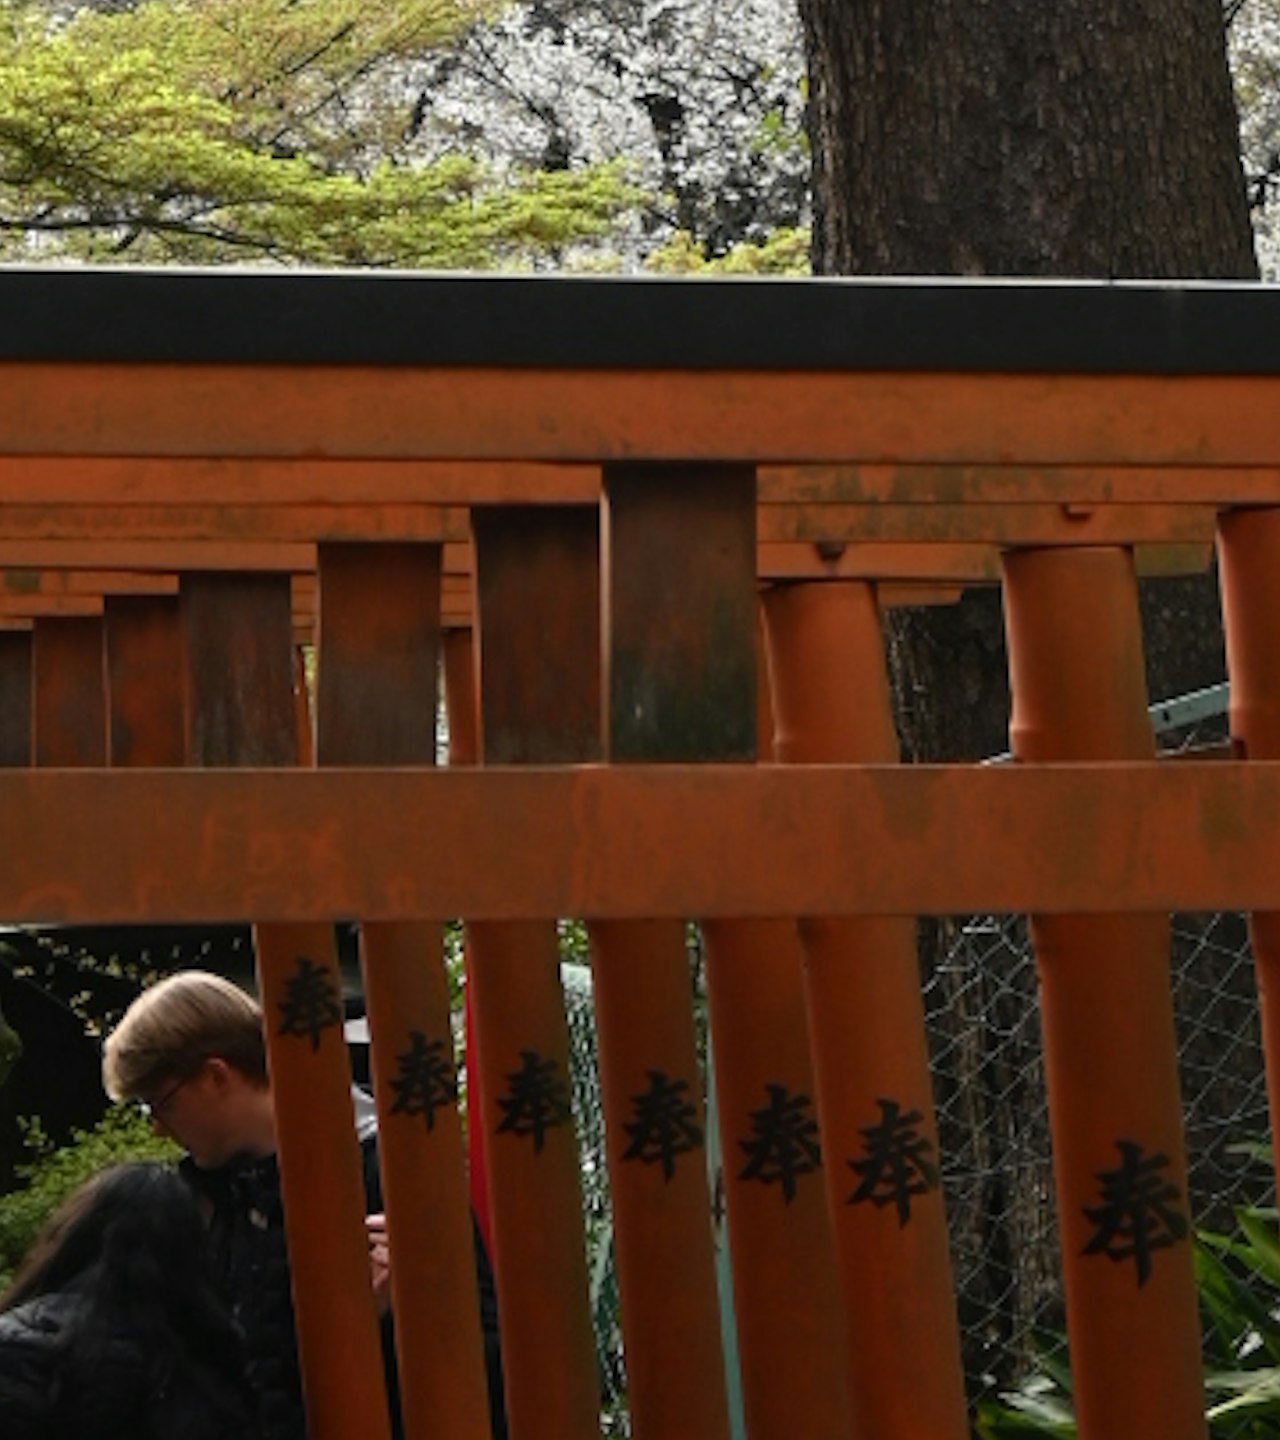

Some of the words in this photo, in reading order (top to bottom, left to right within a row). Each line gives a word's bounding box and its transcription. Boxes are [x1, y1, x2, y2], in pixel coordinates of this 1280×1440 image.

[277, 956, 341, 1053] 奉
[390, 1031, 458, 1131] 奉
[498, 1050, 571, 1155] 奉
[622, 1069, 704, 1183] 奉
[737, 1083, 821, 1205] 奉
[846, 1098, 940, 1229] 奉
[1081, 1140, 1189, 1288] 奉
